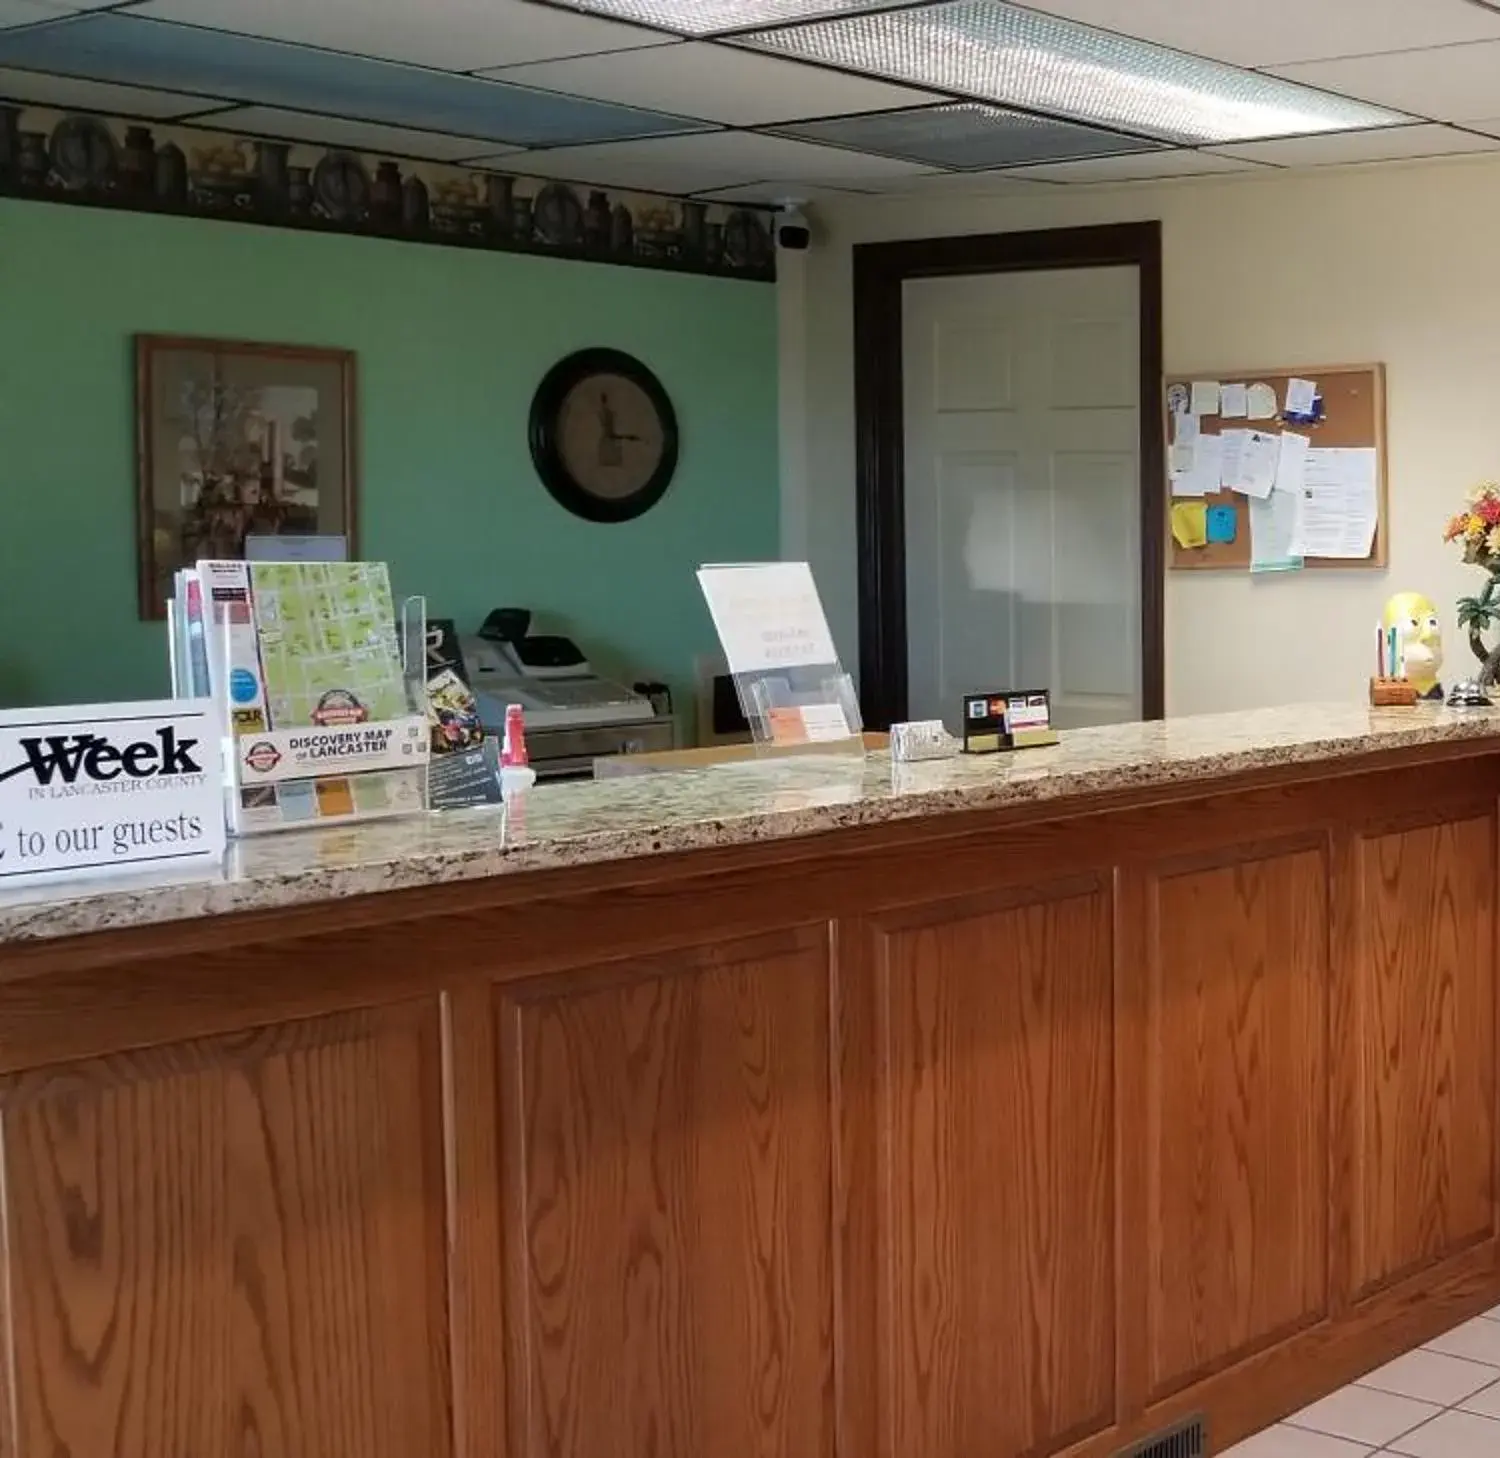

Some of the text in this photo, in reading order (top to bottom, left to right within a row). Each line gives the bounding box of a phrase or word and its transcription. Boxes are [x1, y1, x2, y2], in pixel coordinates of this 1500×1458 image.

[289, 729, 393, 750] DISCOVERY MAP
[309, 740, 387, 759] LANCASTER
[19, 726, 202, 786] Week
[29, 773, 207, 801] IN LANCASTER COUNTY
[18, 826, 45, 858] to
[56, 825, 104, 855] our
[113, 811, 202, 856] guests
